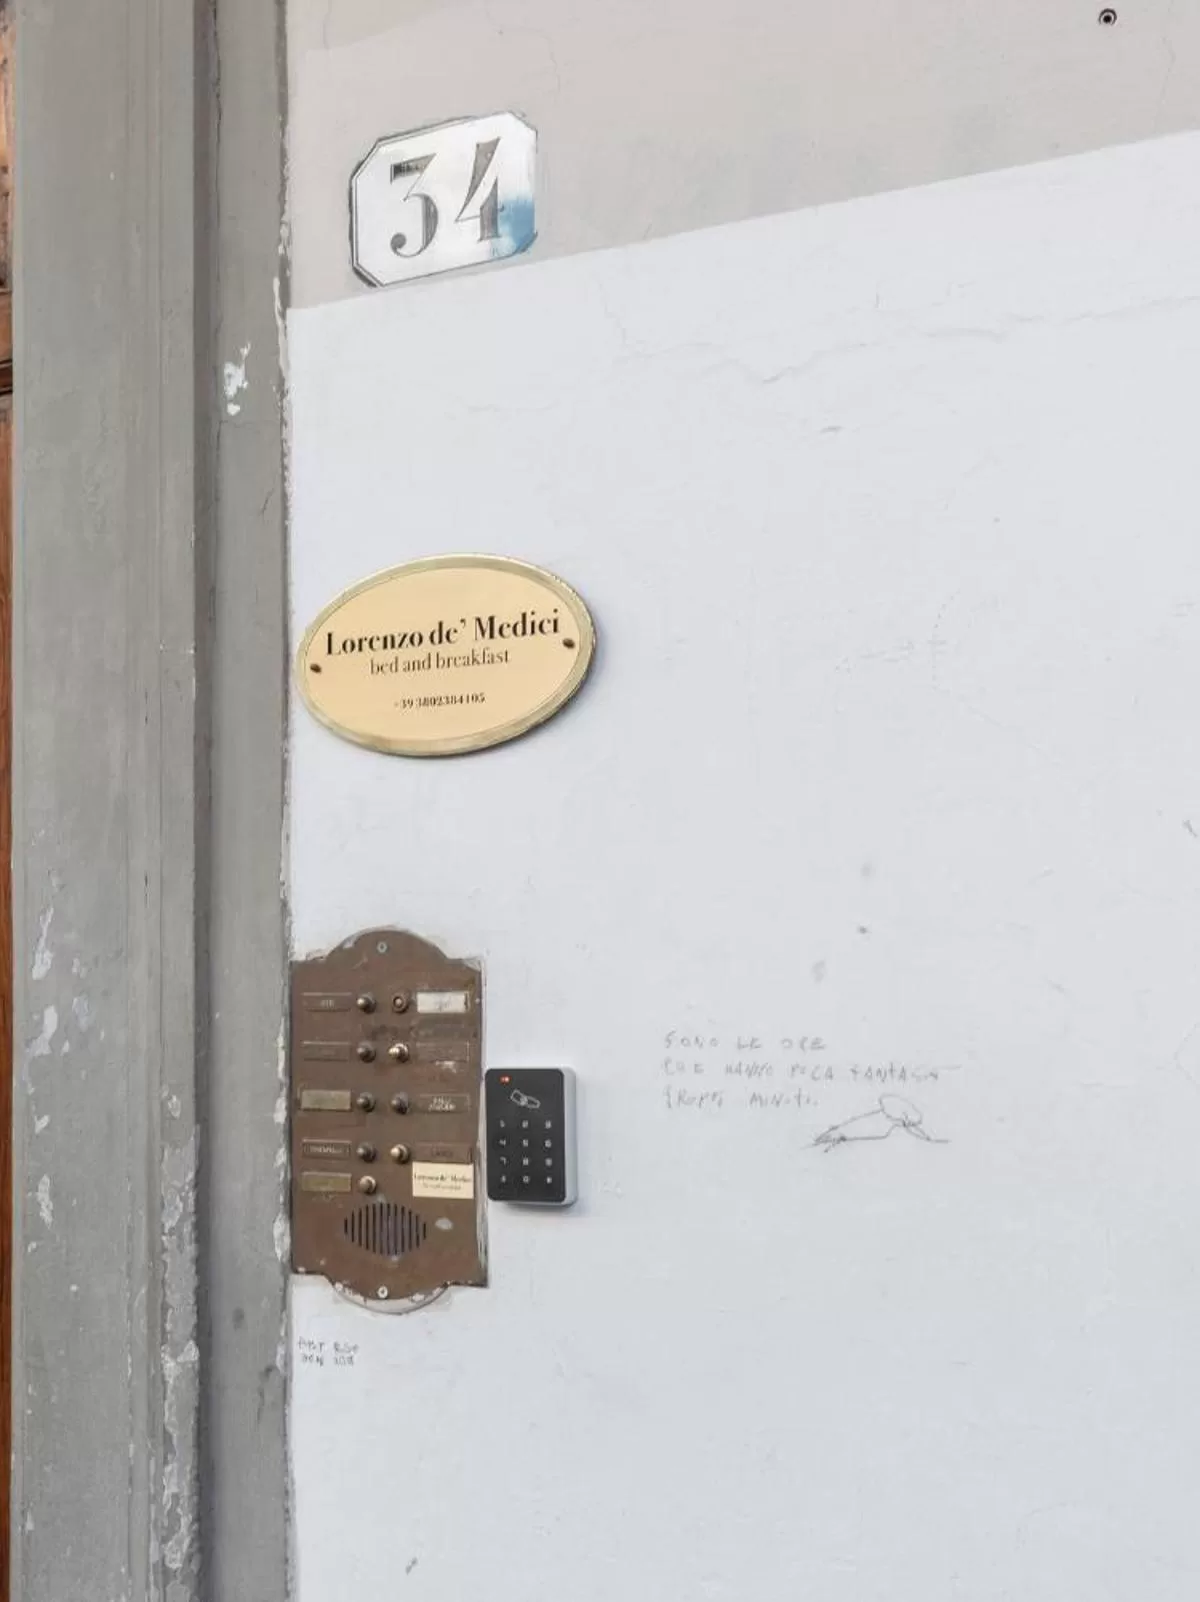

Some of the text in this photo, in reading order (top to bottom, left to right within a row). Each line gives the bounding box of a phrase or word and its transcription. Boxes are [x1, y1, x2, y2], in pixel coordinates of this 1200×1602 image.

[389, 136, 505, 258] 34
[326, 630, 423, 656] Lorenzo
[474, 608, 560, 641] Medici
[370, 647, 510, 675] bed and breakfast
